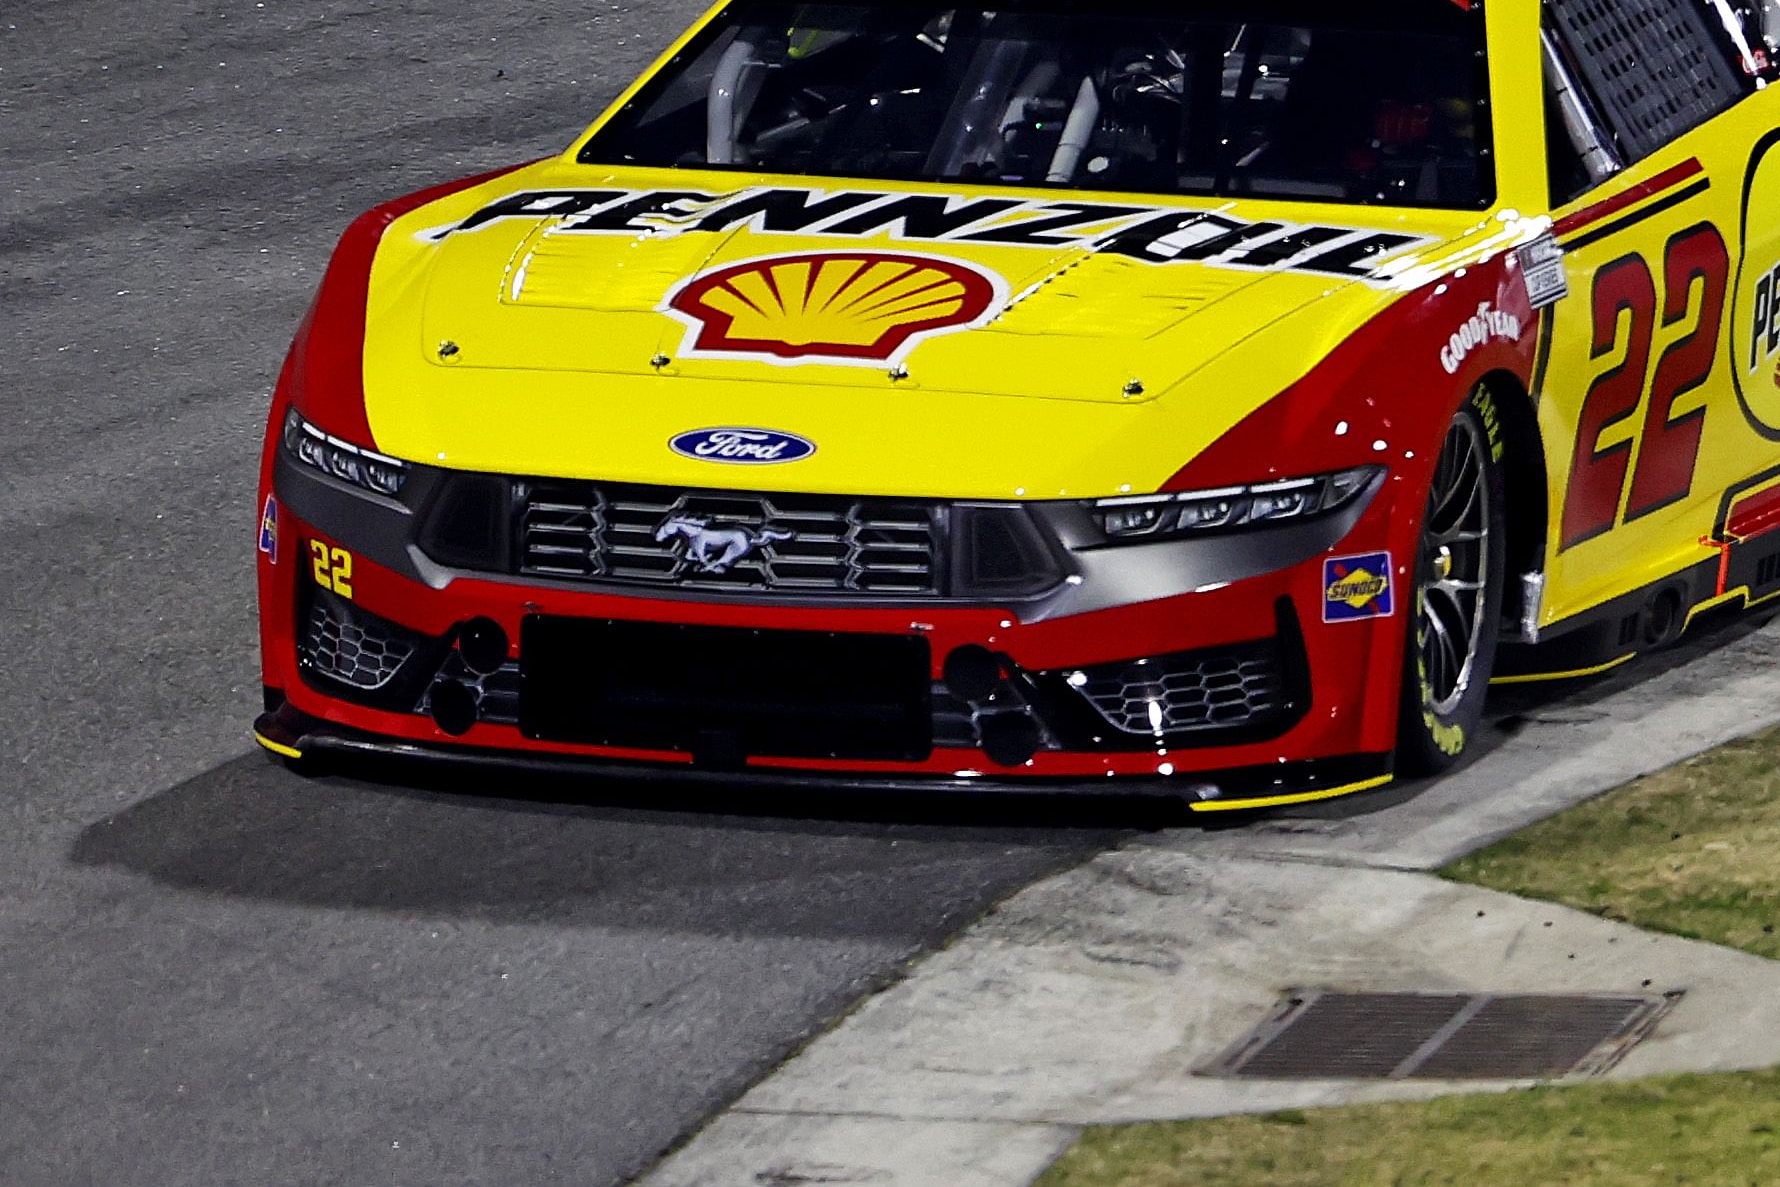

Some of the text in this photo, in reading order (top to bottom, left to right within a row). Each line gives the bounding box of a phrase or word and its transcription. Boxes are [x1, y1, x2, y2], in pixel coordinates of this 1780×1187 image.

[416, 187, 1440, 284] PENNZOIL
[1440, 301, 1521, 375] GOODYEAR
[1558, 219, 1728, 554] 22
[694, 430, 784, 461] Ford
[310, 538, 353, 600] 22
[1327, 579, 1385, 599] SUNOCO
